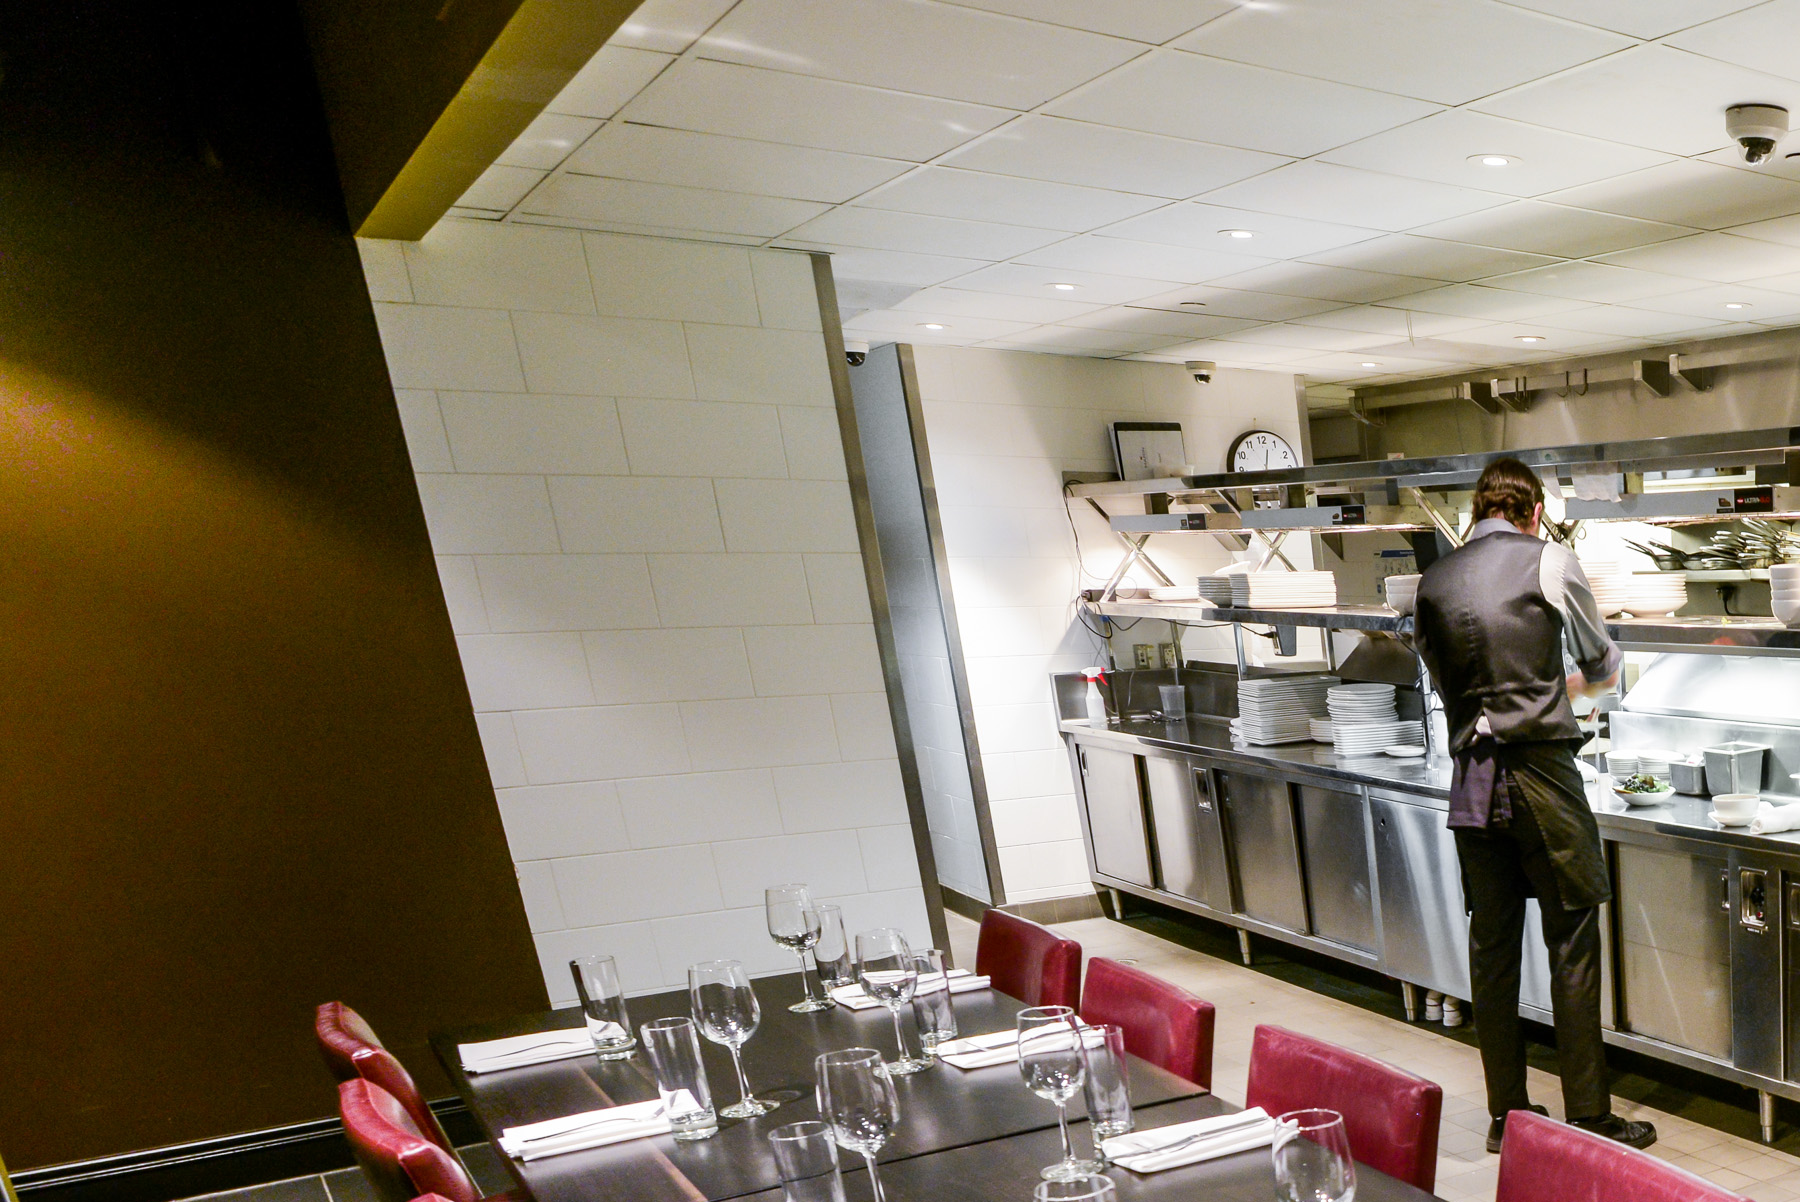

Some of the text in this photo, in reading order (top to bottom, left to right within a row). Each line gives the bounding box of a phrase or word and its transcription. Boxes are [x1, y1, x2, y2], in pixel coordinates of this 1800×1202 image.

[1257, 436, 1267, 444] 12
[1272, 440, 1277, 448] 1
[1245, 440, 1253, 449] 11
[1238, 451, 1246, 460] 10
[1283, 451, 1288, 459] 2
